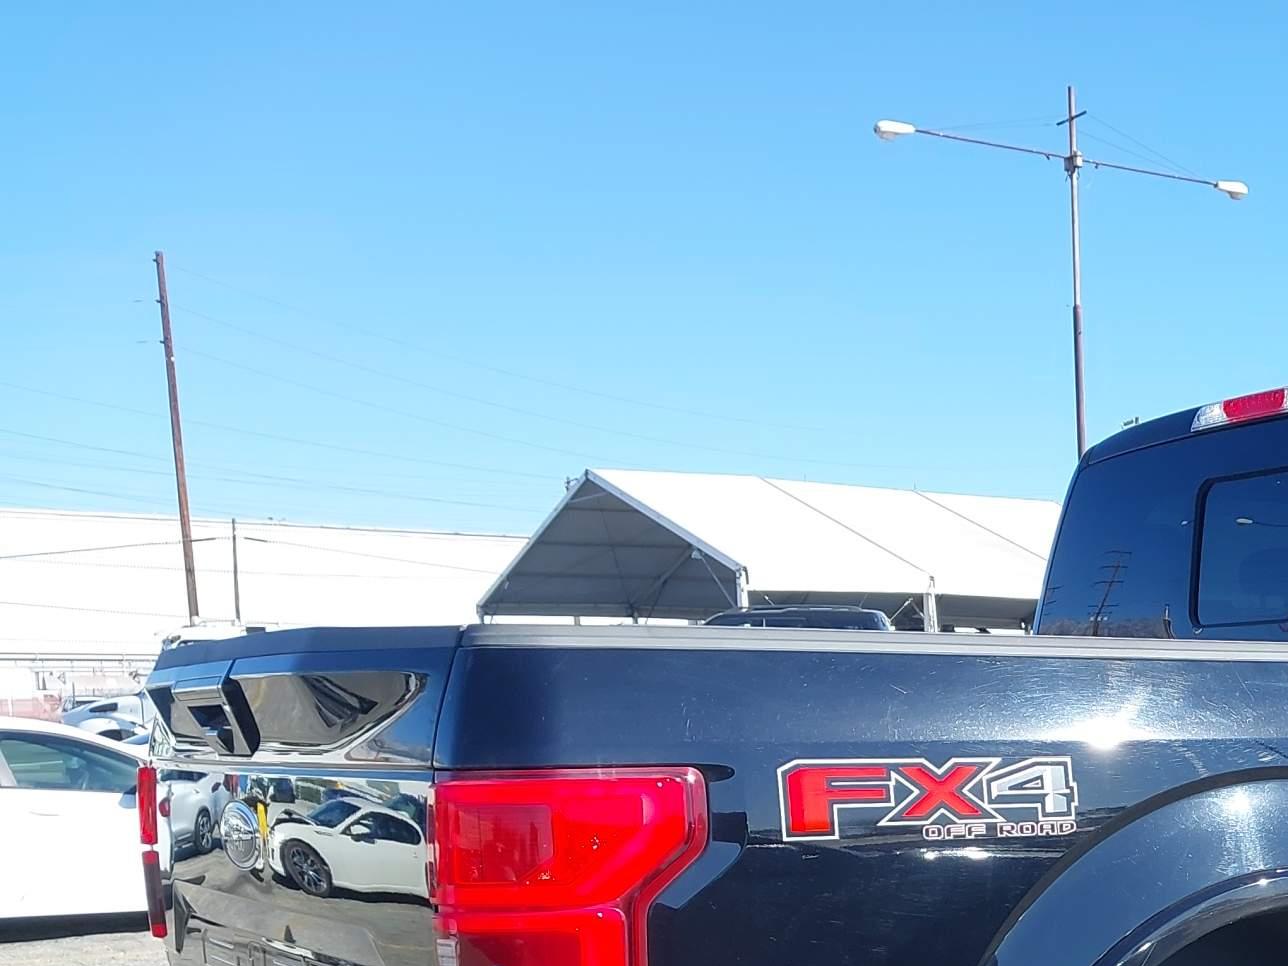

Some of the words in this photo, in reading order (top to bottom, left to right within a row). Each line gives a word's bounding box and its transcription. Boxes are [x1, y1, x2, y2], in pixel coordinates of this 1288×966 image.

[777, 756, 1079, 842] FX4
[922, 824, 988, 841] OFF
[996, 820, 1078, 837] ROAD
